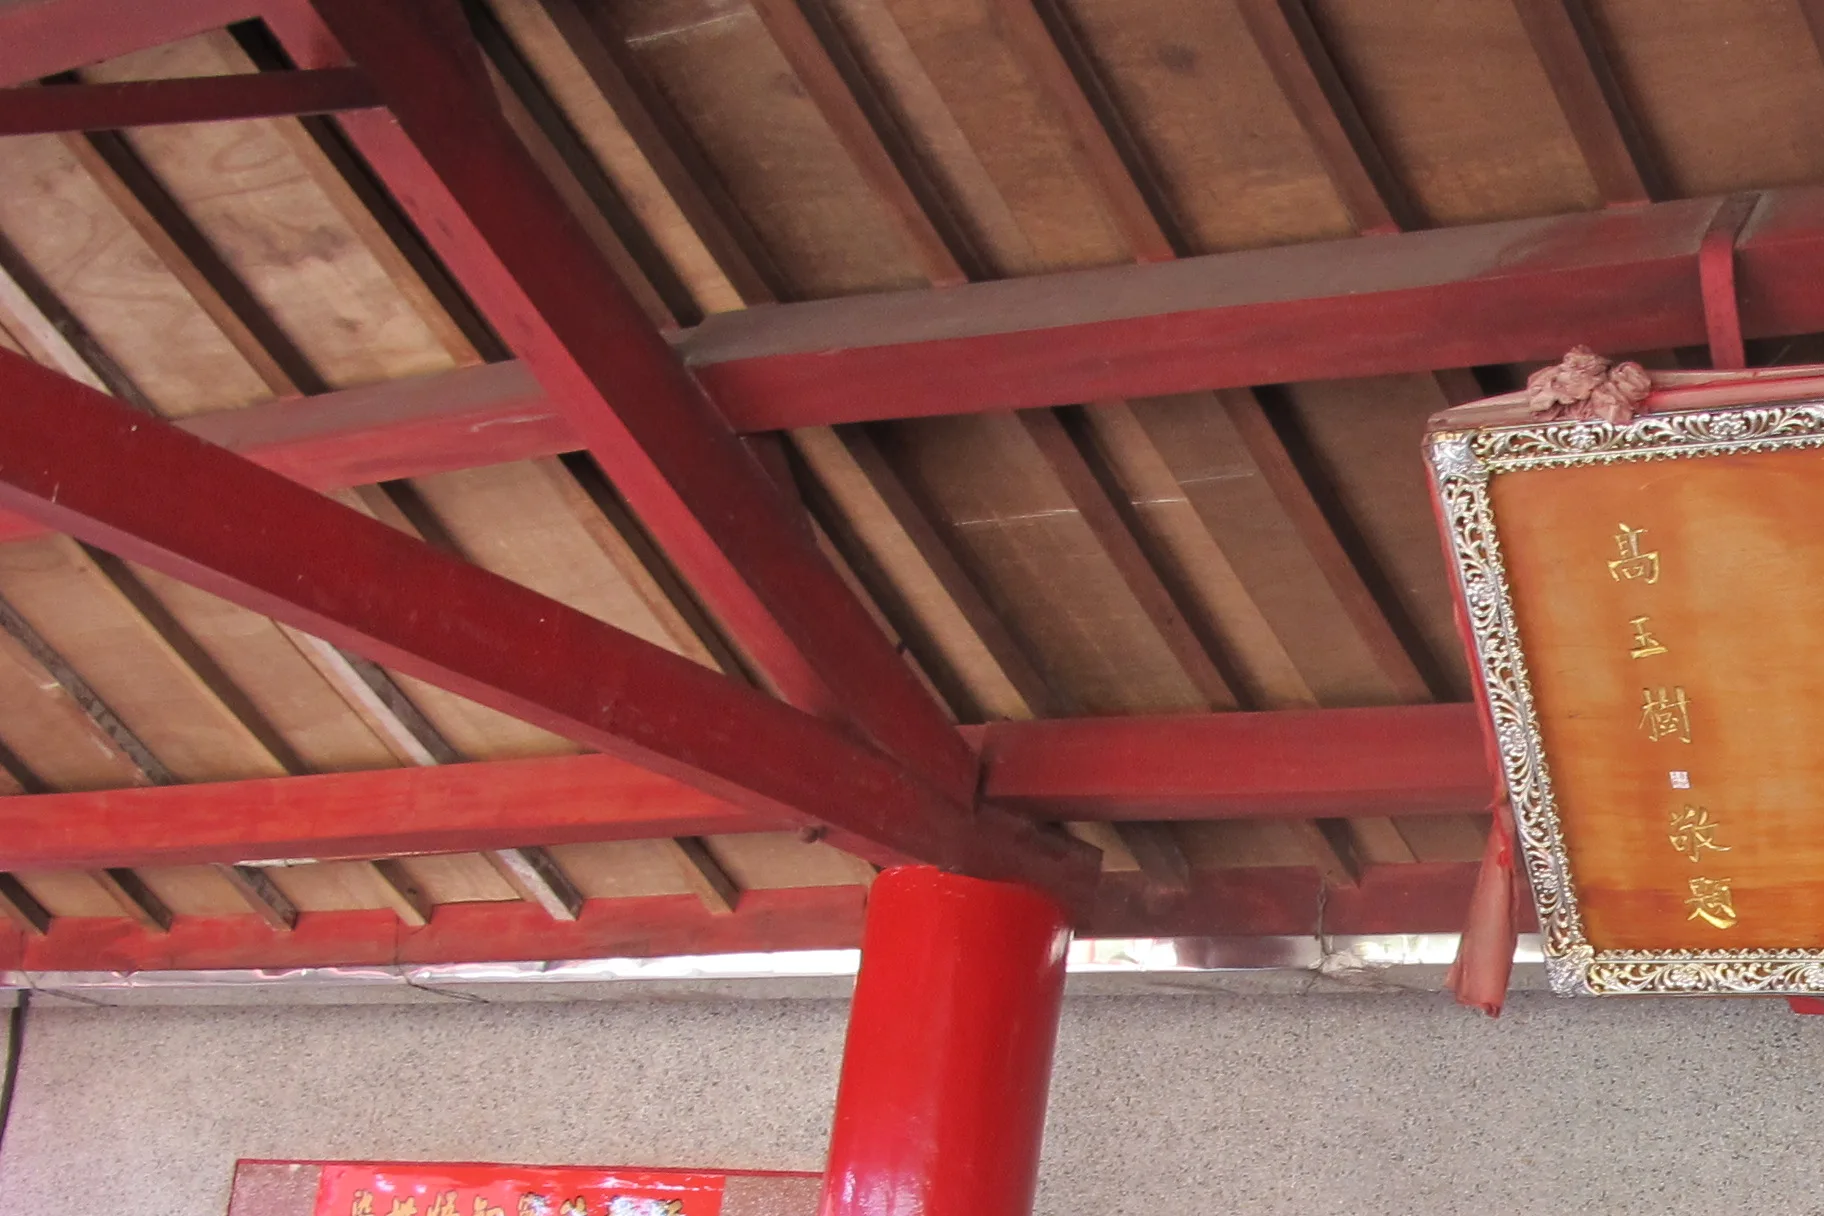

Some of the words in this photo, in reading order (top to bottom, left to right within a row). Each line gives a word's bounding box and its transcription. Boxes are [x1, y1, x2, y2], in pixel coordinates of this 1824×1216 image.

[1606, 522, 1738, 930] 高玉樹敬題
